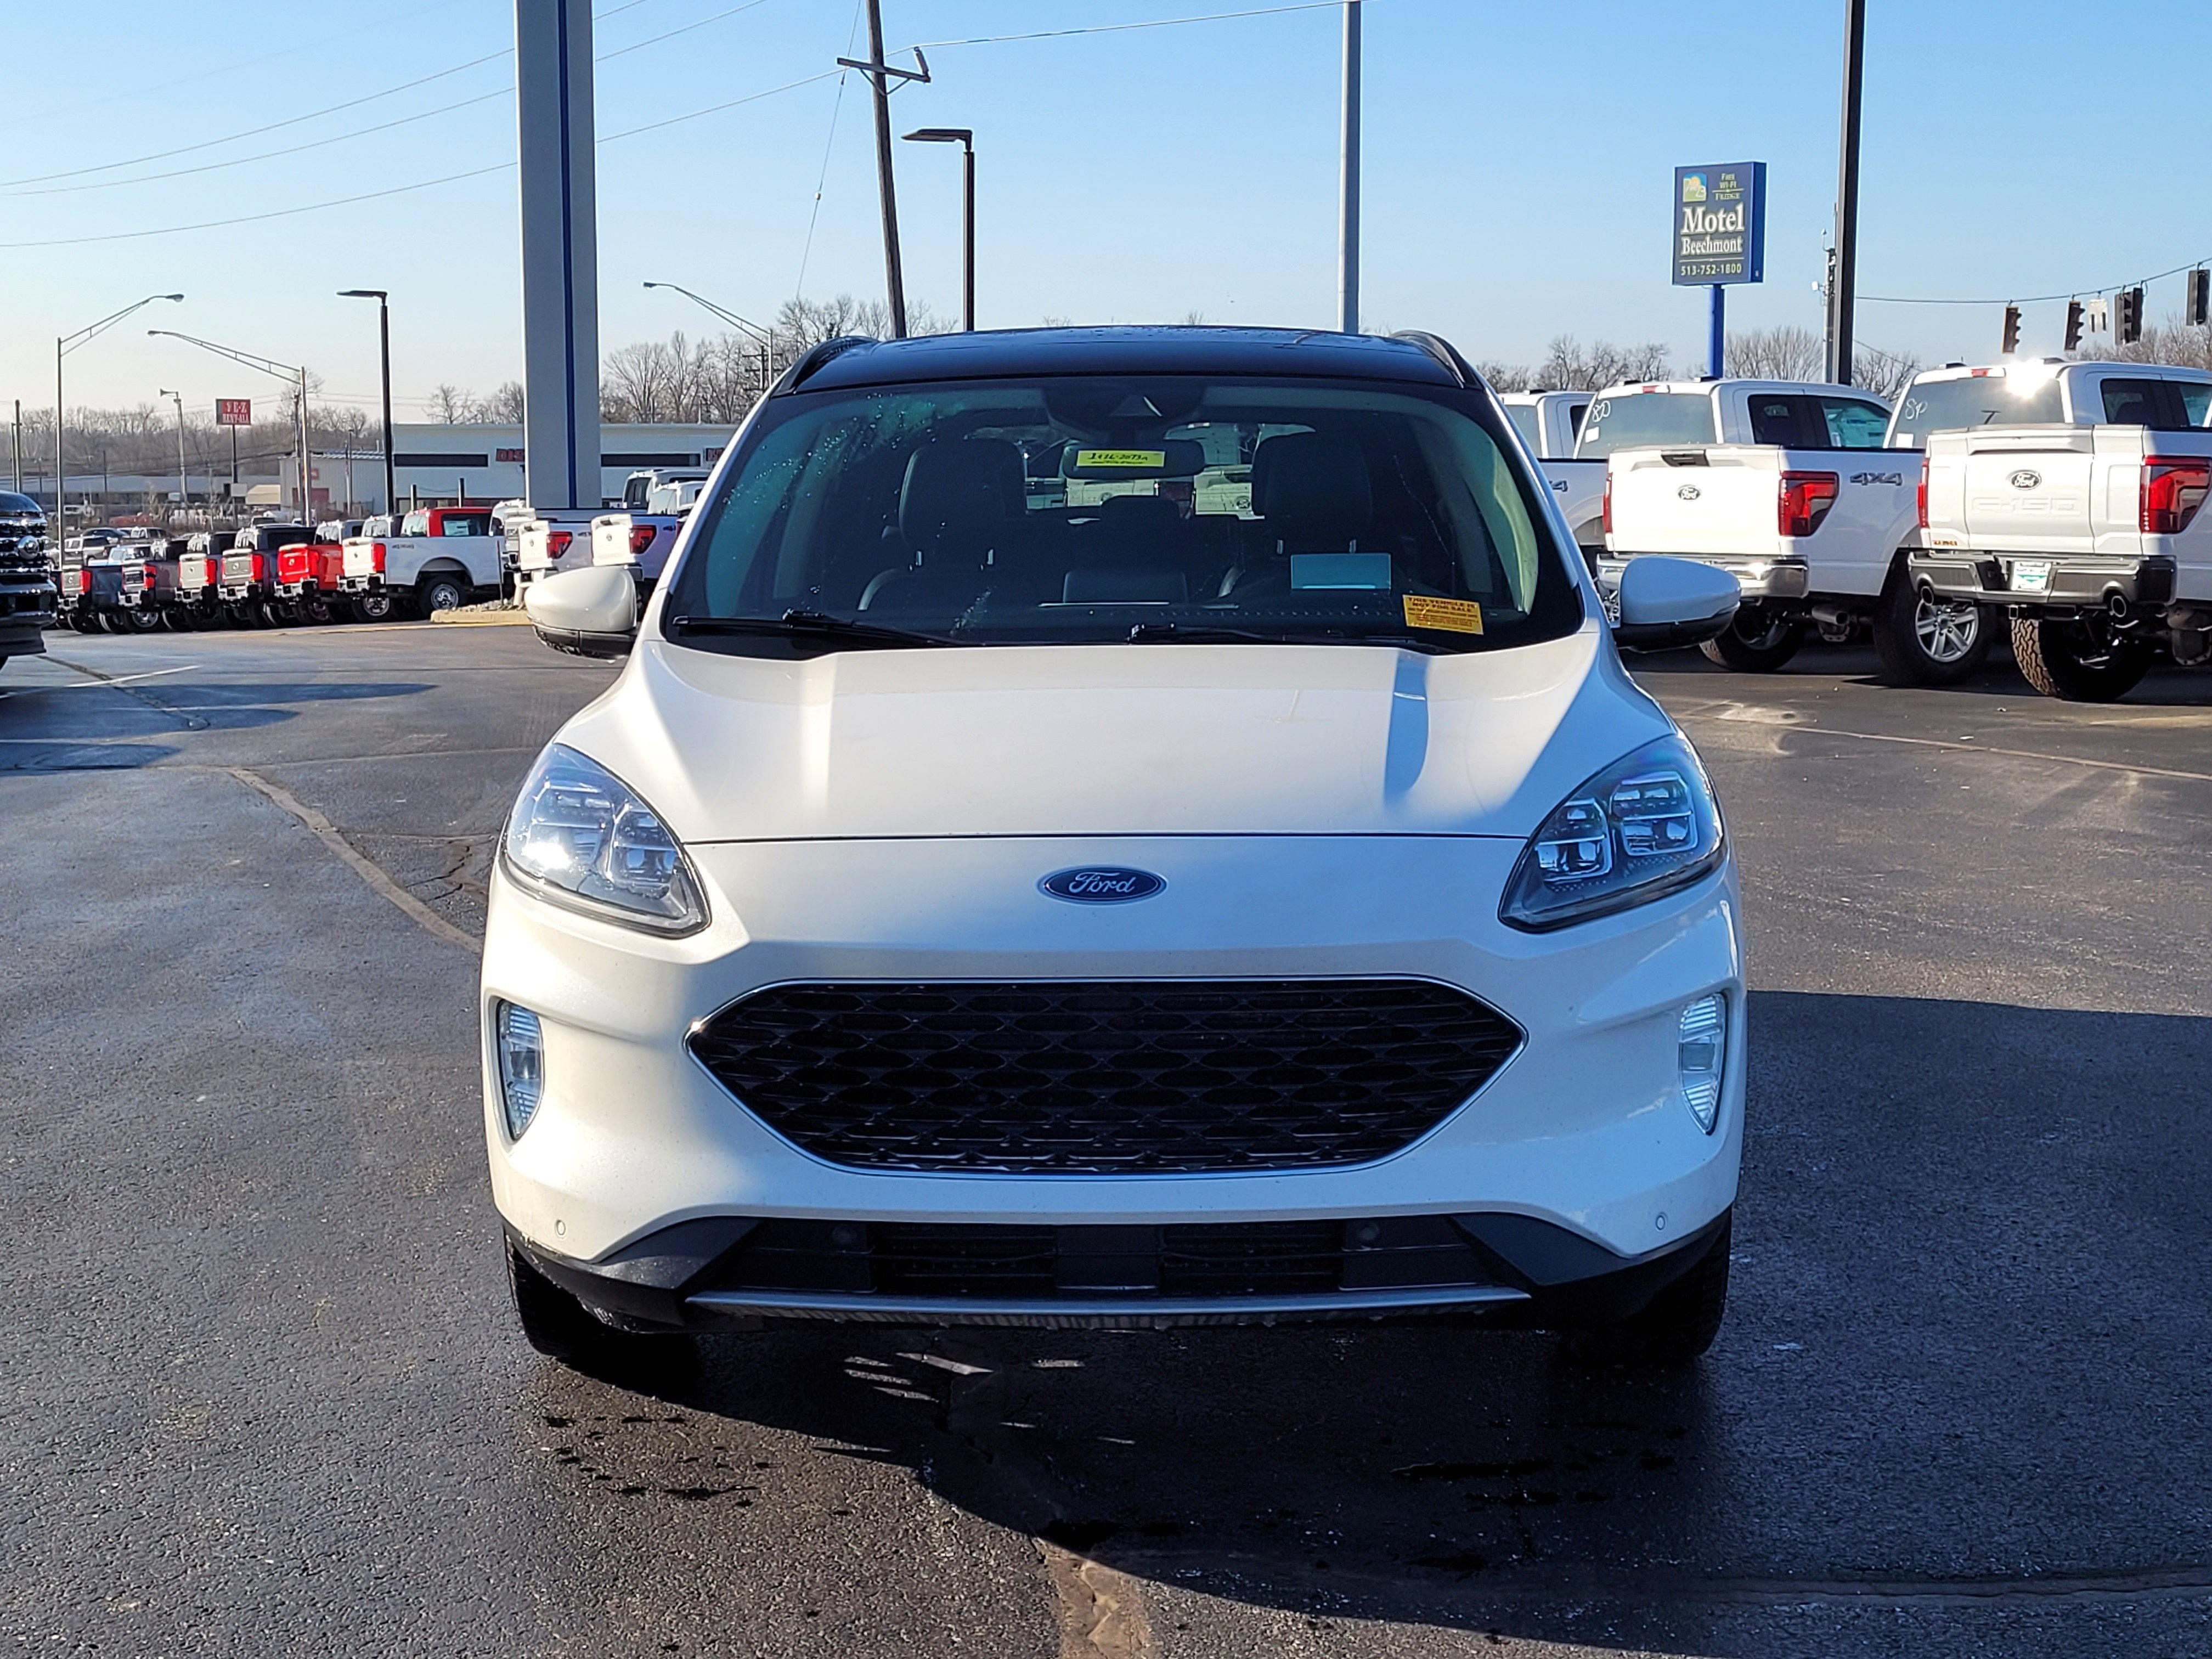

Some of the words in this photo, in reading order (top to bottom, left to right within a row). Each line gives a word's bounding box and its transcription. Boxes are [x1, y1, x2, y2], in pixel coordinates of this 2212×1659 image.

[1680, 202, 1745, 234] Motel
[1680, 234, 1743, 256] Beechmont
[1069, 872, 1137, 893] Ford
